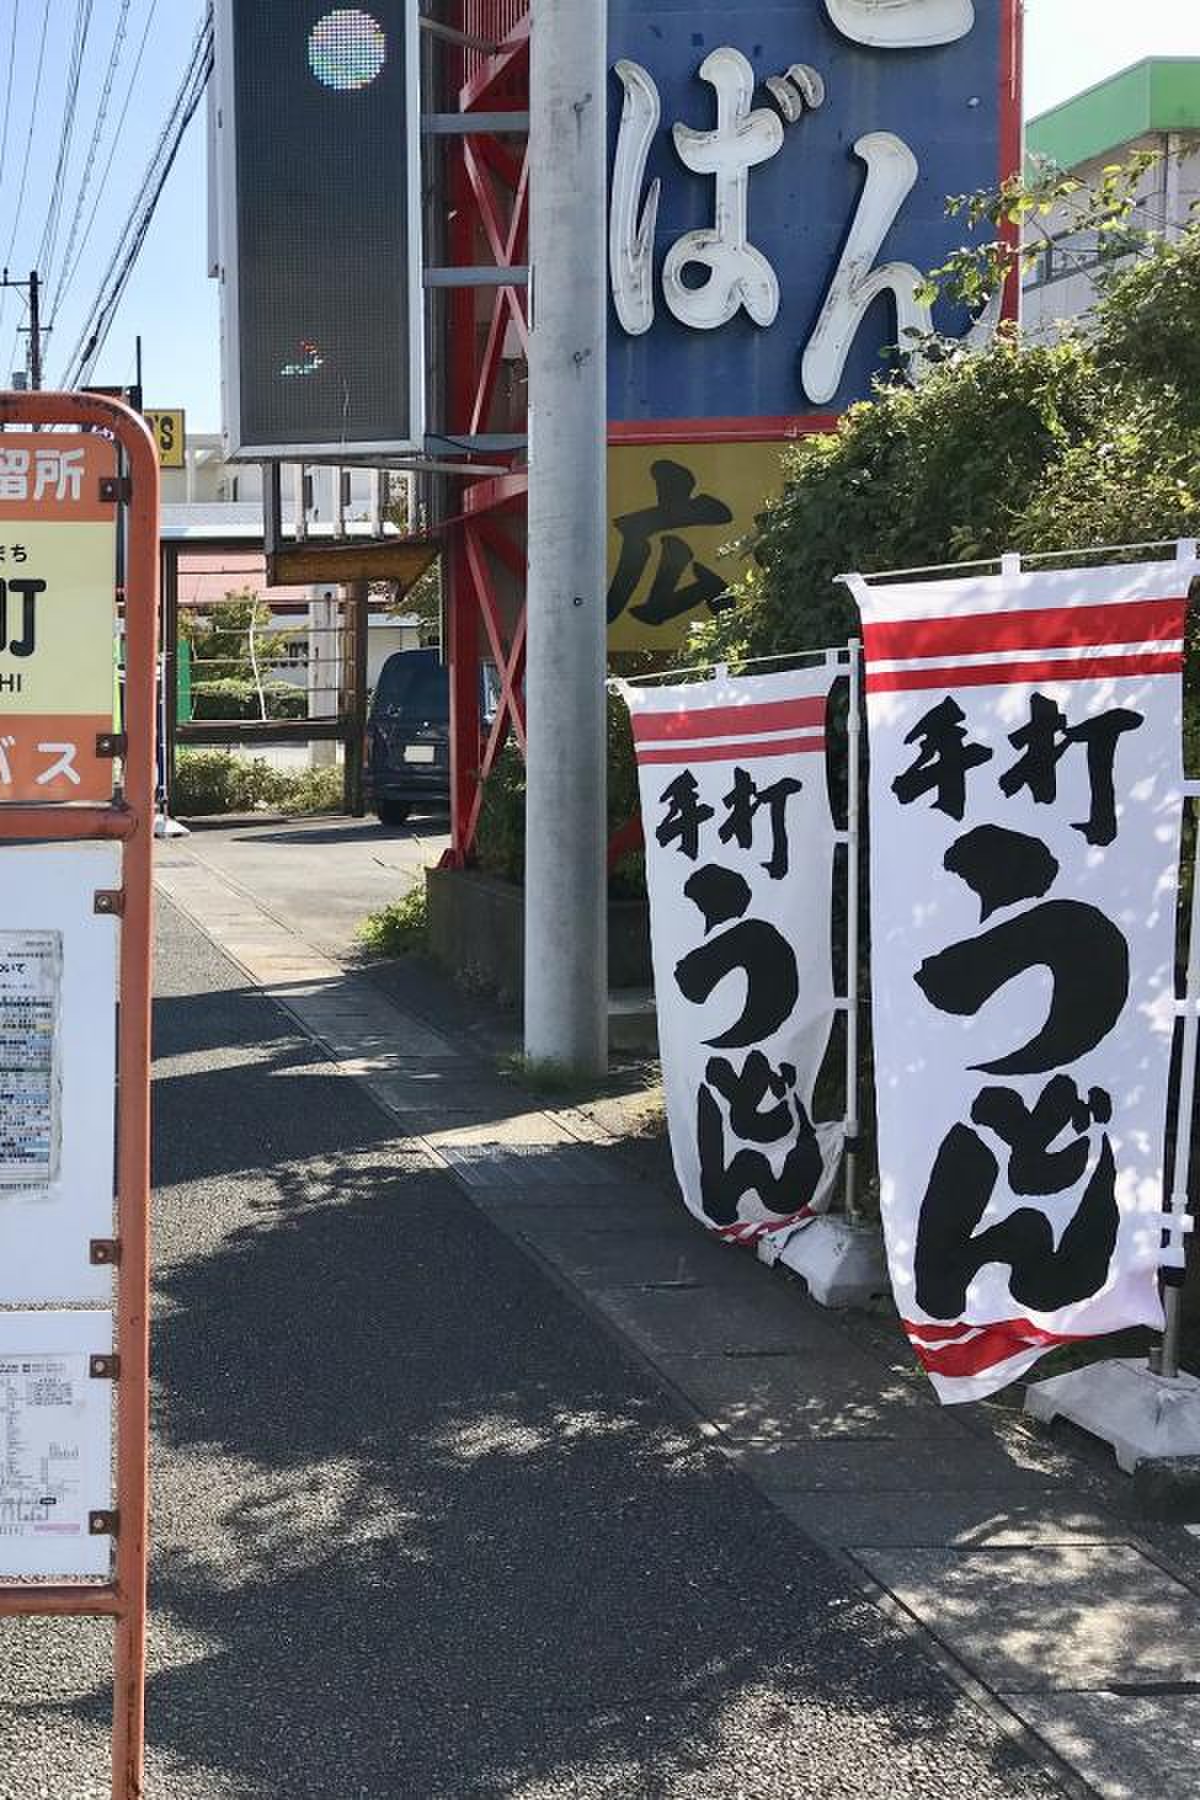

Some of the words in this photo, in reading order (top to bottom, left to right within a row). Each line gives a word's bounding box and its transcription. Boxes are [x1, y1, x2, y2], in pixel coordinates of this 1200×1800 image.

[606, 459, 734, 627] 広
[655, 765, 803, 880] 手打
[891, 690, 1146, 848] 手打
[673, 862, 825, 1226] うどん
[912, 823, 1130, 1321] うどん
